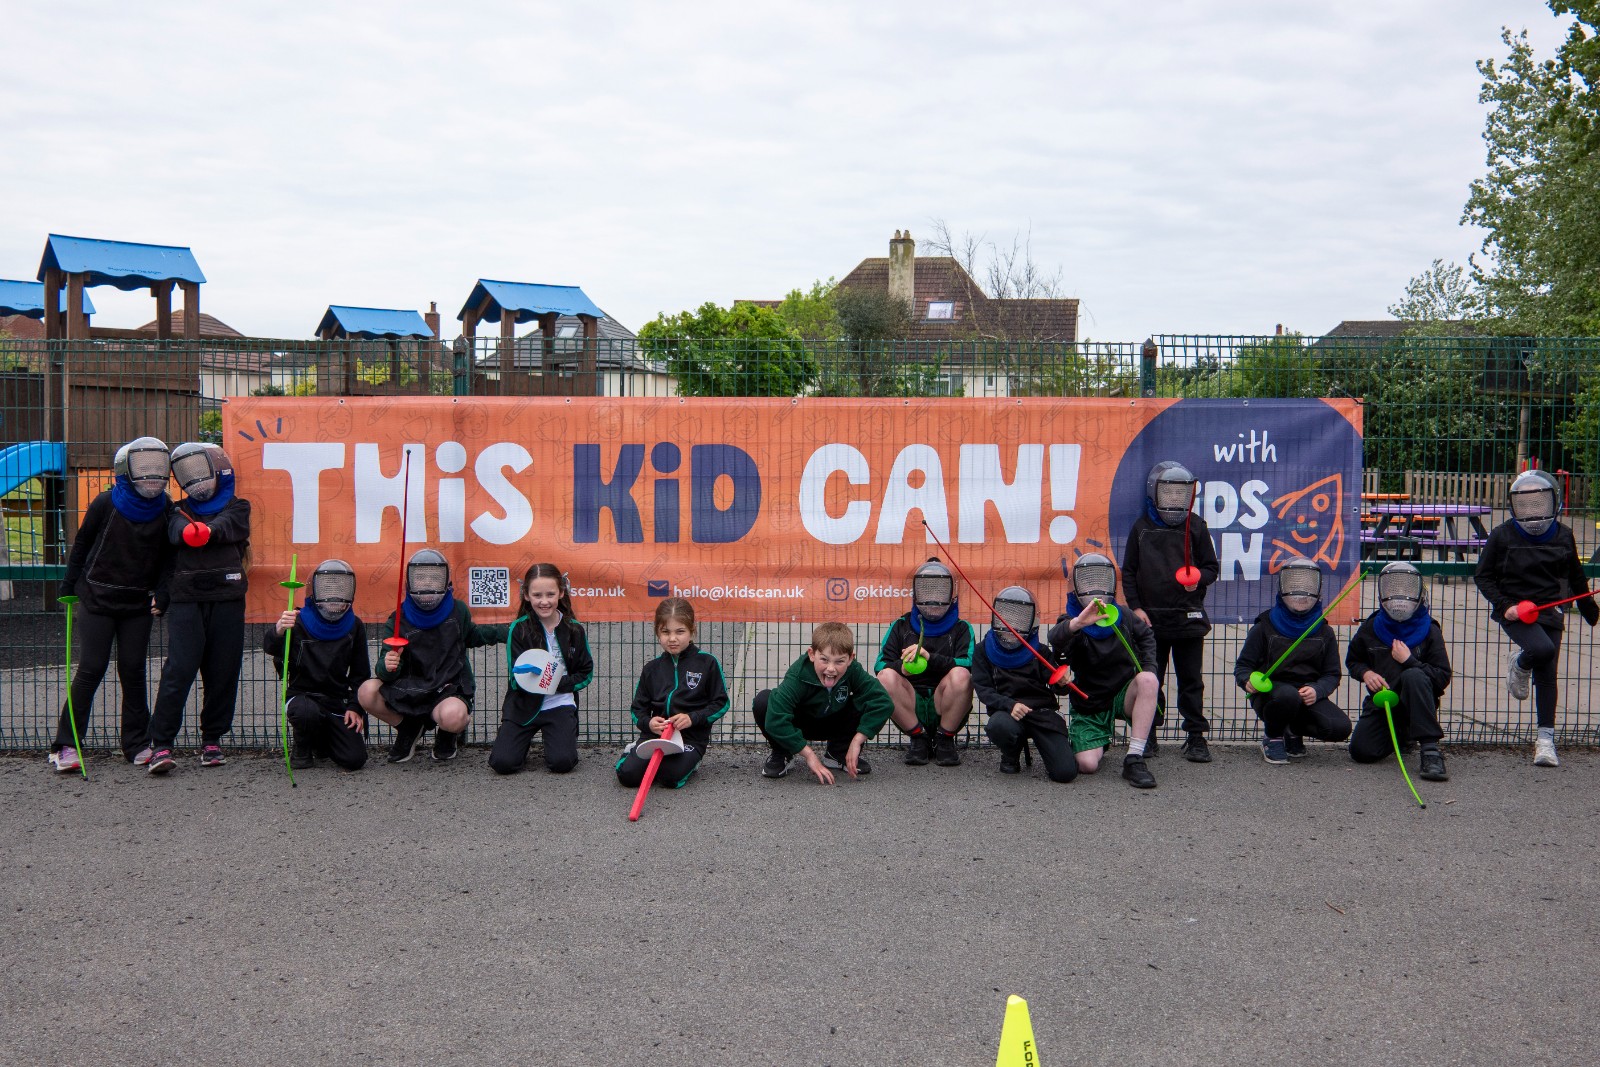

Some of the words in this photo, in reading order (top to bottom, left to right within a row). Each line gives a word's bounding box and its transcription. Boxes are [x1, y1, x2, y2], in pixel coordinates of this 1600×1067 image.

[1213, 429, 1277, 463] with
[799, 443, 1081, 544] CAN!
[1193, 479, 1270, 529] DS
[570, 585, 626, 597] scan.uk
[673, 585, 805, 601] hello@kidscan.uk
[853, 584, 914, 601] @kidsca
